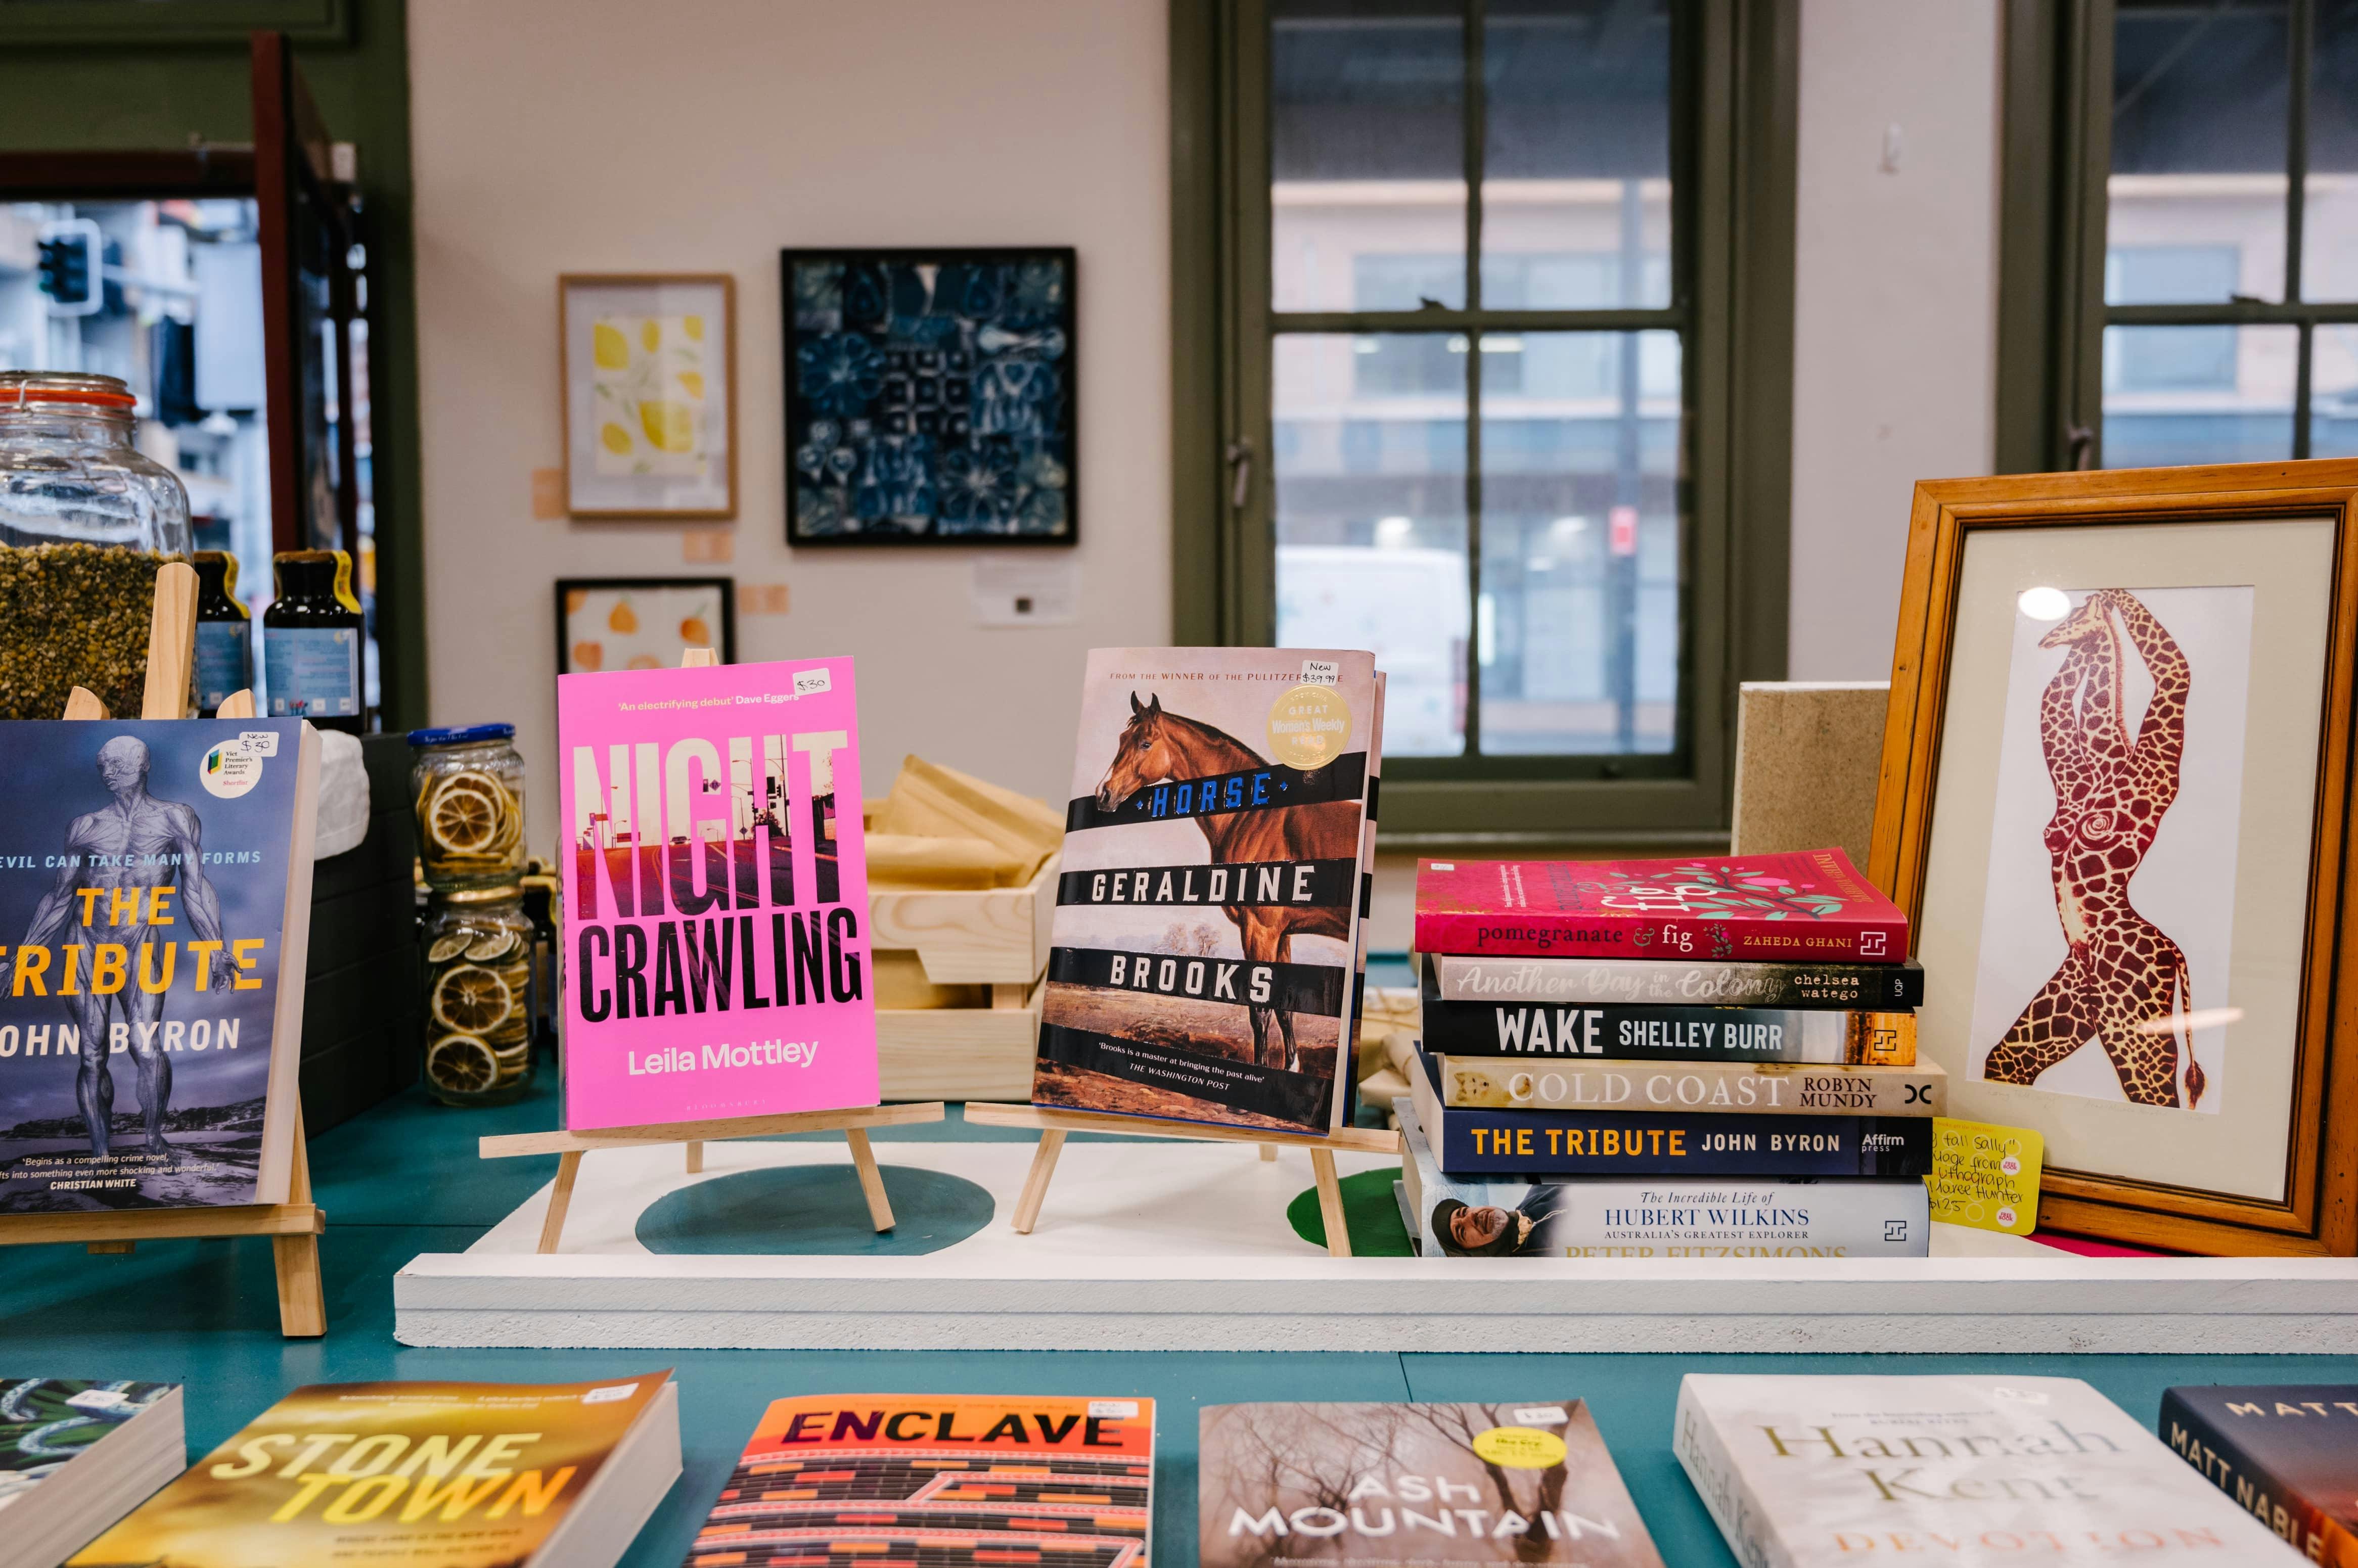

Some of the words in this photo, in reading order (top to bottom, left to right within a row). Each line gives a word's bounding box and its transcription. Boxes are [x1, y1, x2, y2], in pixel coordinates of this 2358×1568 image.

[1310, 662, 1331, 671] New
[797, 679, 825, 691] $30
[1247, 673, 1301, 681] PULITZER
[1302, 673, 1335, 683] $39.99
[638, 699, 698, 710] electrifying
[736, 695, 762, 705] Dave
[764, 693, 799, 704] Eggers
[1289, 705, 1328, 715] GREAT
[1273, 719, 1310, 734] Women's
[1312, 718, 1345, 733] Weekly
[1151, 772, 1272, 817] HORSE
[573, 729, 848, 921] NIGHT
[46, 856, 80, 867] CAN
[88, 854, 134, 867] TAKE
[143, 853, 194, 866] MANY
[202, 851, 261, 865] FORMS
[1092, 865, 1316, 902] GERALDINE
[76, 886, 176, 927] THE
[1477, 925, 1623, 948] pomegranate
[1634, 928, 1655, 947] &
[1662, 924, 1693, 952] fig
[1743, 936, 1800, 946] ZAHEDA
[1806, 938, 1852, 948] GHANI
[0, 938, 265, 998] RIBUTE
[578, 907, 863, 1023] CRAWLING
[1110, 955, 1274, 1003] BROOKS
[1457, 965, 1578, 995] Another
[1581, 967, 1646, 1001] Day
[1675, 968, 1787, 1003] Colony
[1653, 971, 1670, 983] in
[1794, 974, 1860, 985] chelsea
[1649, 984, 1673, 998] the
[1802, 988, 1858, 1000] watego
[1894, 979, 1903, 997] UQP
[0, 1024, 80, 1057] OHN
[109, 1018, 240, 1054] BYRON
[1495, 1007, 1603, 1054] WAKE
[1619, 1020, 1715, 1048] SHELLEY
[1724, 1024, 1783, 1050] BURR
[628, 1046, 695, 1076] Leila
[702, 1038, 819, 1069] Mottley
[1127, 1047, 1134, 1056] is
[1142, 1052, 1167, 1063] master
[1179, 1058, 1210, 1073] bringing
[1212, 1066, 1225, 1075] the
[1226, 1070, 1242, 1080] past
[1129, 1063, 1146, 1073] THE
[1148, 1067, 1205, 1086] WASHINGTON
[1206, 1079, 1230, 1091] POST
[1803, 1077, 1873, 1092] ROBYN
[1509, 1072, 1631, 1103] COLD
[1646, 1075, 1789, 1106] COAST
[1799, 1093, 1877, 1108] MUNDY
[1471, 1129, 1534, 1155] THE
[1545, 1129, 1686, 1157] TRIBUTE
[1701, 1134, 1756, 1151] JOHN
[1771, 1134, 1840, 1152] BYRON
[1862, 1133, 1904, 1146] Affirm
[1943, 1134, 1968, 1146] tall
[1862, 1145, 1890, 1153] press
[74, 1154, 119, 1167] compelling
[120, 1154, 144, 1163] crime
[146, 1152, 169, 1163] novel,
[1970, 1157, 2001, 1173] from
[12, 1170, 28, 1179] into
[30, 1168, 73, 1180] something
[96, 1168, 119, 1176] more
[120, 1165, 155, 1176] shocking
[157, 1165, 173, 1174] and
[50, 1180, 103, 1190] CHRISTIAN
[105, 1178, 137, 1188] WHITE
[1641, 1191, 1663, 1203] The
[1668, 1191, 1727, 1203] Incredible
[1732, 1191, 1758, 1205] Life
[1761, 1191, 1776, 1205] of
[1605, 1209, 1700, 1226] HUBERT
[1707, 1209, 1809, 1226] WILKINS
[1605, 1230, 1680, 1239] AUSTRALIA'S
[1685, 1231, 1744, 1239] GREATEST
[1749, 1231, 1808, 1239] EXPLORER
[1565, 1246, 1654, 1258] PETER
[2225, 1402, 2358, 1417] MATT
[781, 1411, 1124, 1448] ENCLAVE
[1757, 1420, 2128, 1458] Hannah
[211, 1433, 542, 1480] STONE
[270, 1466, 578, 1525] TOWN
[1349, 1475, 1481, 1503] ASH
[2171, 1421, 2232, 1489] MATT
[2237, 1474, 2325, 1564] NABLE
[1229, 1506, 1620, 1540] MOUNTAIN
[1832, 1526, 2223, 1554] DEVOTION
